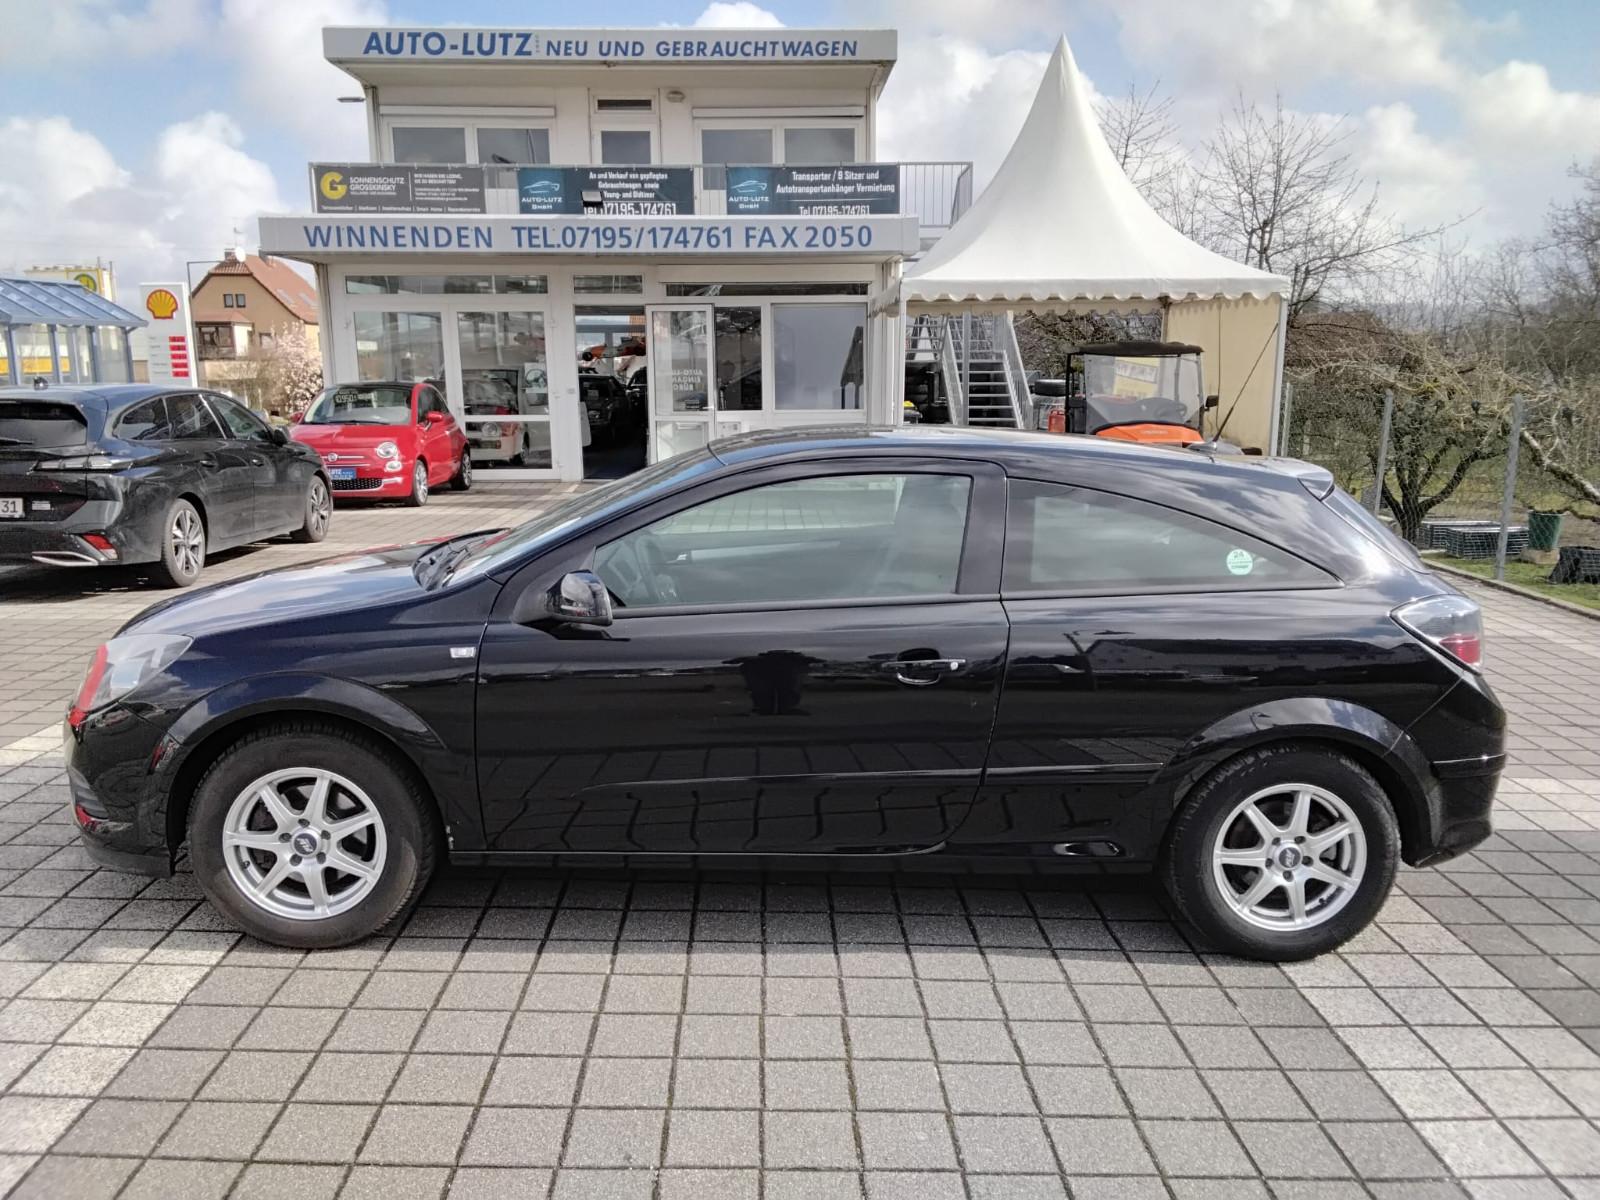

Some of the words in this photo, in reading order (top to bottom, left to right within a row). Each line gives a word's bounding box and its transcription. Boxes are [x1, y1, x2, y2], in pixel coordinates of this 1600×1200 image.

[362, 31, 533, 56] AUTO-LUTZ
[546, 40, 588, 56] NEU
[598, 40, 645, 57] UND
[655, 40, 858, 57] GEBRAUCHTWAGEN
[349, 176, 405, 185] SONNENSCHUTZ
[597, 171, 607, 179] und
[608, 171, 629, 179] Verkauf
[640, 171, 668, 181] gepflegten
[792, 171, 831, 182] Transporter
[832, 169, 837, 181] /
[838, 170, 843, 180] 9
[844, 170, 865, 180] Sitzer
[866, 169, 880, 180] und
[598, 181, 642, 190] Gebrauchtwagen
[644, 181, 660, 189] sowie
[776, 183, 855, 195] Autotransportanhänger
[856, 182, 896, 193] Vermietung
[303, 225, 493, 248] WINNENDEN
[744, 225, 799, 249] FAX
[804, 225, 873, 248] 2050
